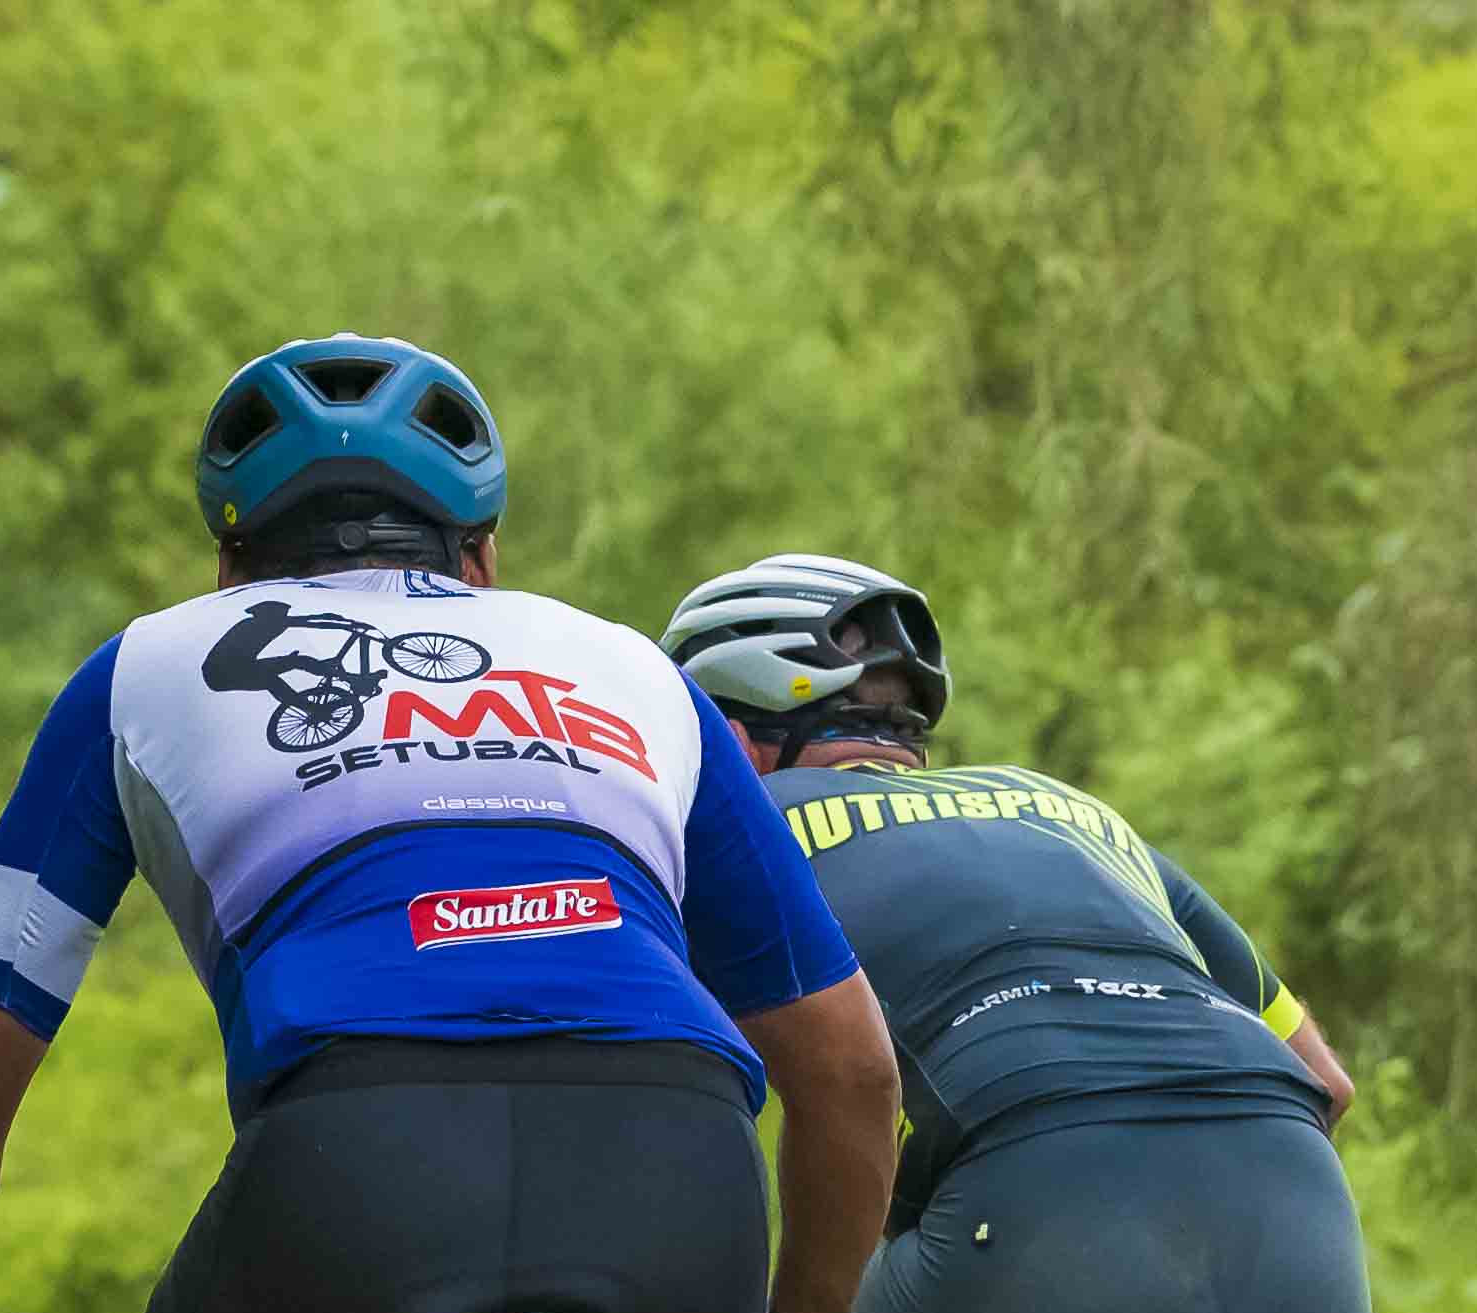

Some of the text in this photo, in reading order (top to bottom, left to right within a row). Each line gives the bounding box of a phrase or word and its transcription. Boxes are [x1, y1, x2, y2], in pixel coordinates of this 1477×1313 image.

[383, 670, 658, 784] MTB
[295, 740, 602, 792] SETUBAL
[422, 795, 567, 813] classique
[432, 888, 597, 932] Santa Fe
[951, 979, 1052, 1027] GARMIN
